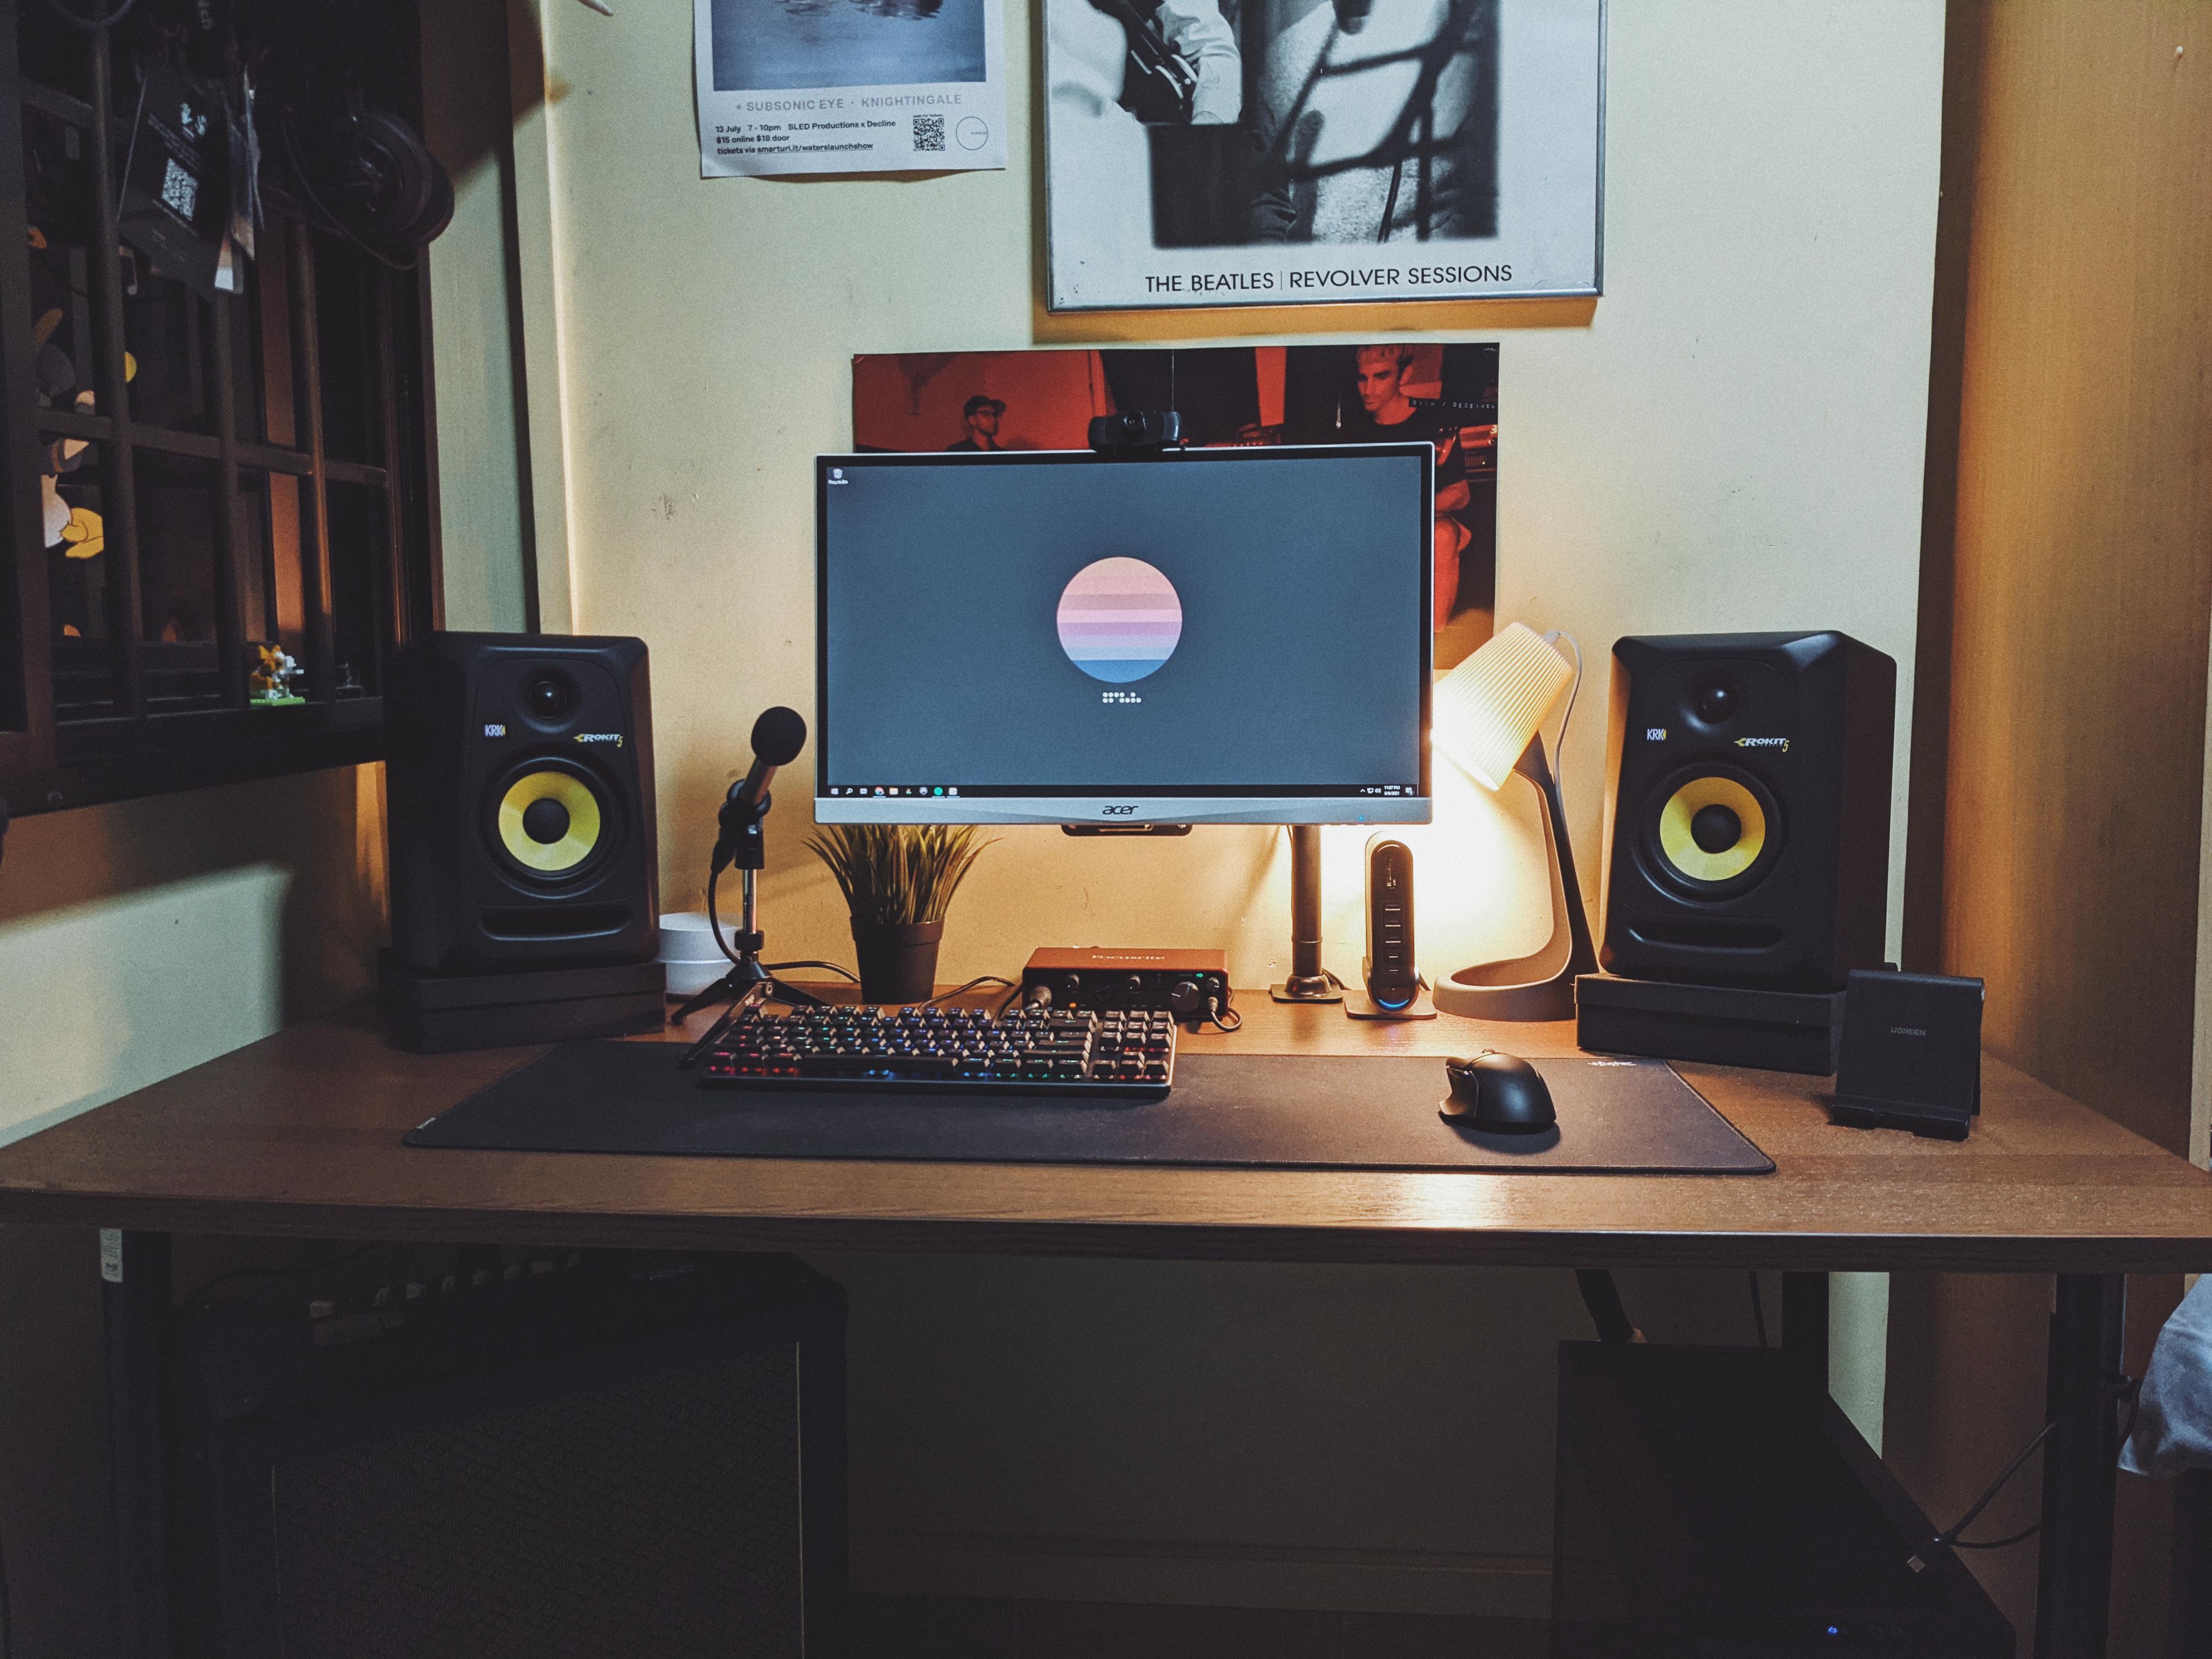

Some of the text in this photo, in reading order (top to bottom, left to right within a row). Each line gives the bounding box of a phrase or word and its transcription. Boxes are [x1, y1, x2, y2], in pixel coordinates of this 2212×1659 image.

[747, 100, 815, 111] SUBSONIC
[819, 99, 844, 109] EYE
[861, 94, 961, 107] KNIGHTINGALE
[726, 125, 741, 133] July
[812, 121, 859, 129] Productions
[716, 136, 730, 144] $15
[1146, 275, 1182, 292] THE
[1192, 272, 1274, 291] BEATLES
[1290, 268, 1400, 288] REVOLVER
[1408, 265, 1512, 284] SESSIONS
[484, 724, 504, 737] KRK
[1647, 729, 1664, 741] KRK
[583, 733, 620, 742] ROKIT
[1745, 738, 1790, 753] ROKIT 5
[1102, 805, 1138, 815] acer
[1891, 1026, 1926, 1036] UGREEN
